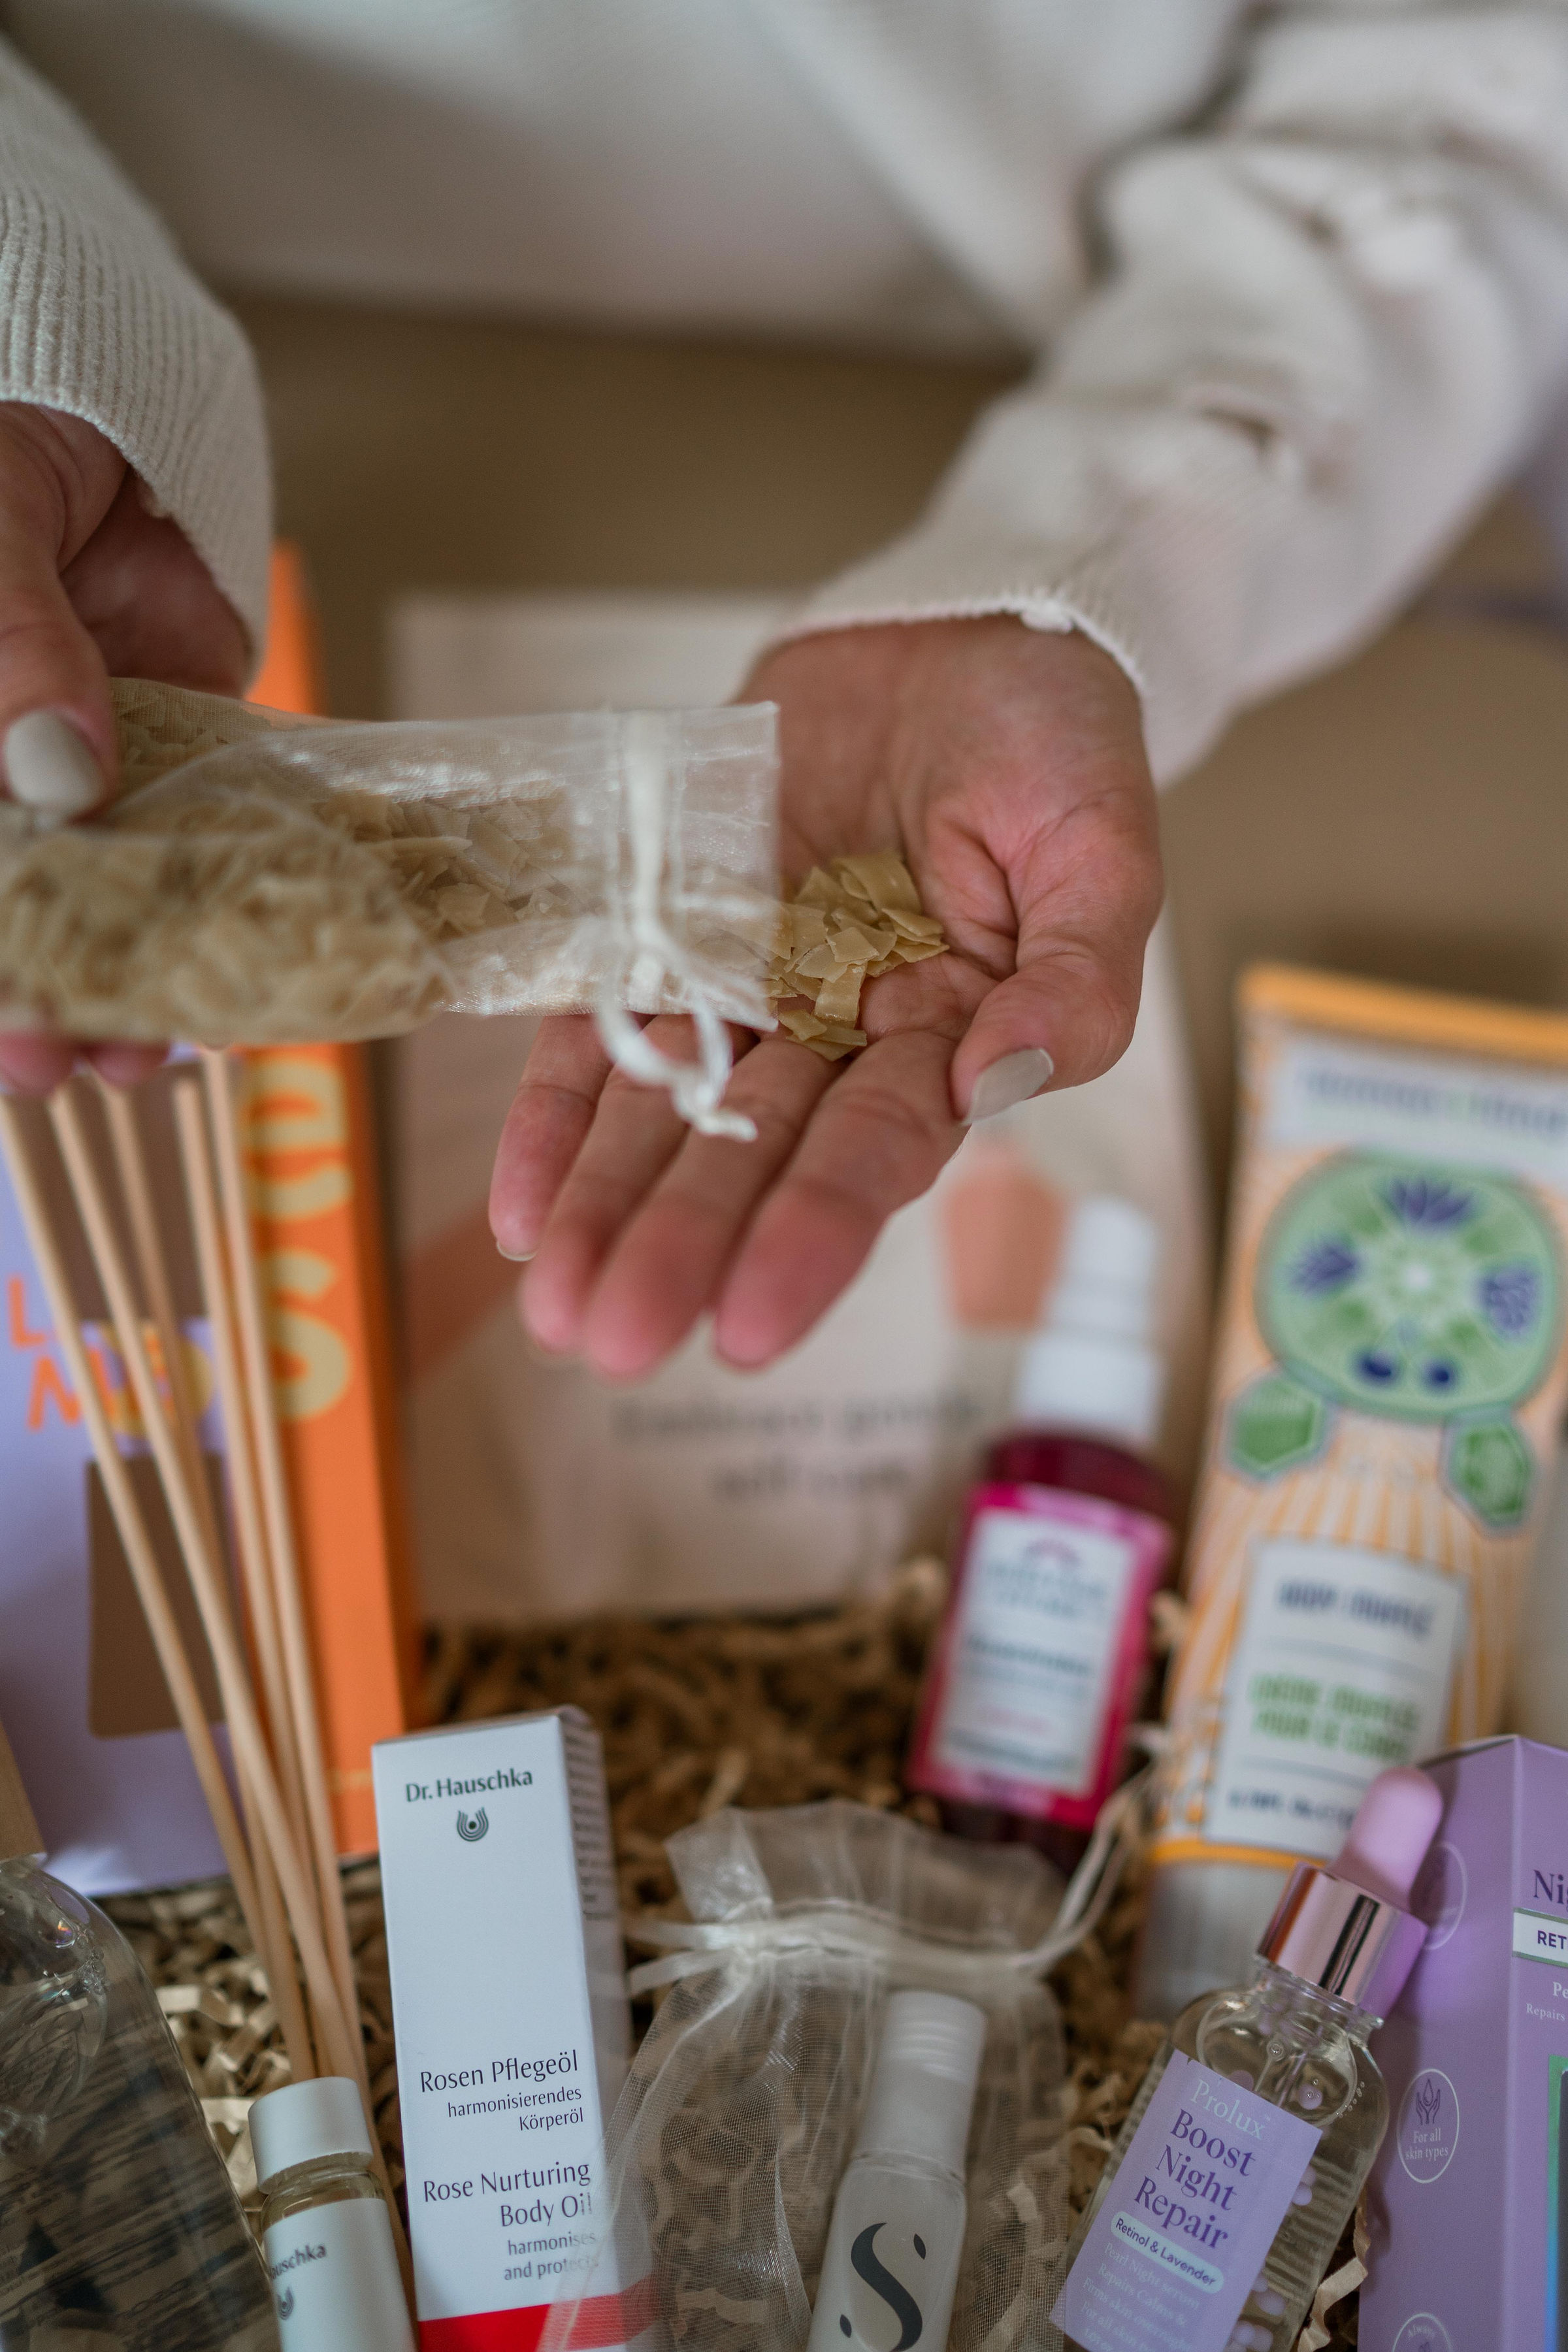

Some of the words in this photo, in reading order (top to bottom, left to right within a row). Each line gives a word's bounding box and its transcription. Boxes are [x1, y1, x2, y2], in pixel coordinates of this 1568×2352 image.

[405, 1783, 433, 1802] Dr.
[436, 1767, 532, 1797] Hauschka
[1526, 2002, 1565, 2022] Repairs
[420, 2068, 483, 2093] Rosen
[492, 2049, 578, 2082] Pflegeöl
[448, 2086, 582, 2117] harmonisierendes
[519, 2107, 583, 2131] Körperöl
[1190, 2078, 1266, 2141] Prolux
[1170, 2108, 1256, 2176] Boost
[1406, 2147, 1423, 2160] skin
[1426, 2146, 1448, 2161] types
[1413, 2130, 1428, 2144] For
[1429, 2127, 1441, 2142] all
[423, 2180, 474, 2202] Rose
[481, 2161, 591, 2195] Nurturing
[1155, 2144, 1237, 2211] Night
[500, 2199, 554, 2227] Body
[561, 2192, 592, 2218] Oil
[1134, 2176, 1229, 2249] Repair
[269, 2243, 327, 2280] auschka
[1115, 2217, 1151, 2247] Retinol
[1150, 2241, 1158, 2254] &
[1160, 2247, 1217, 2285] Lavender
[504, 2261, 532, 2280] and
